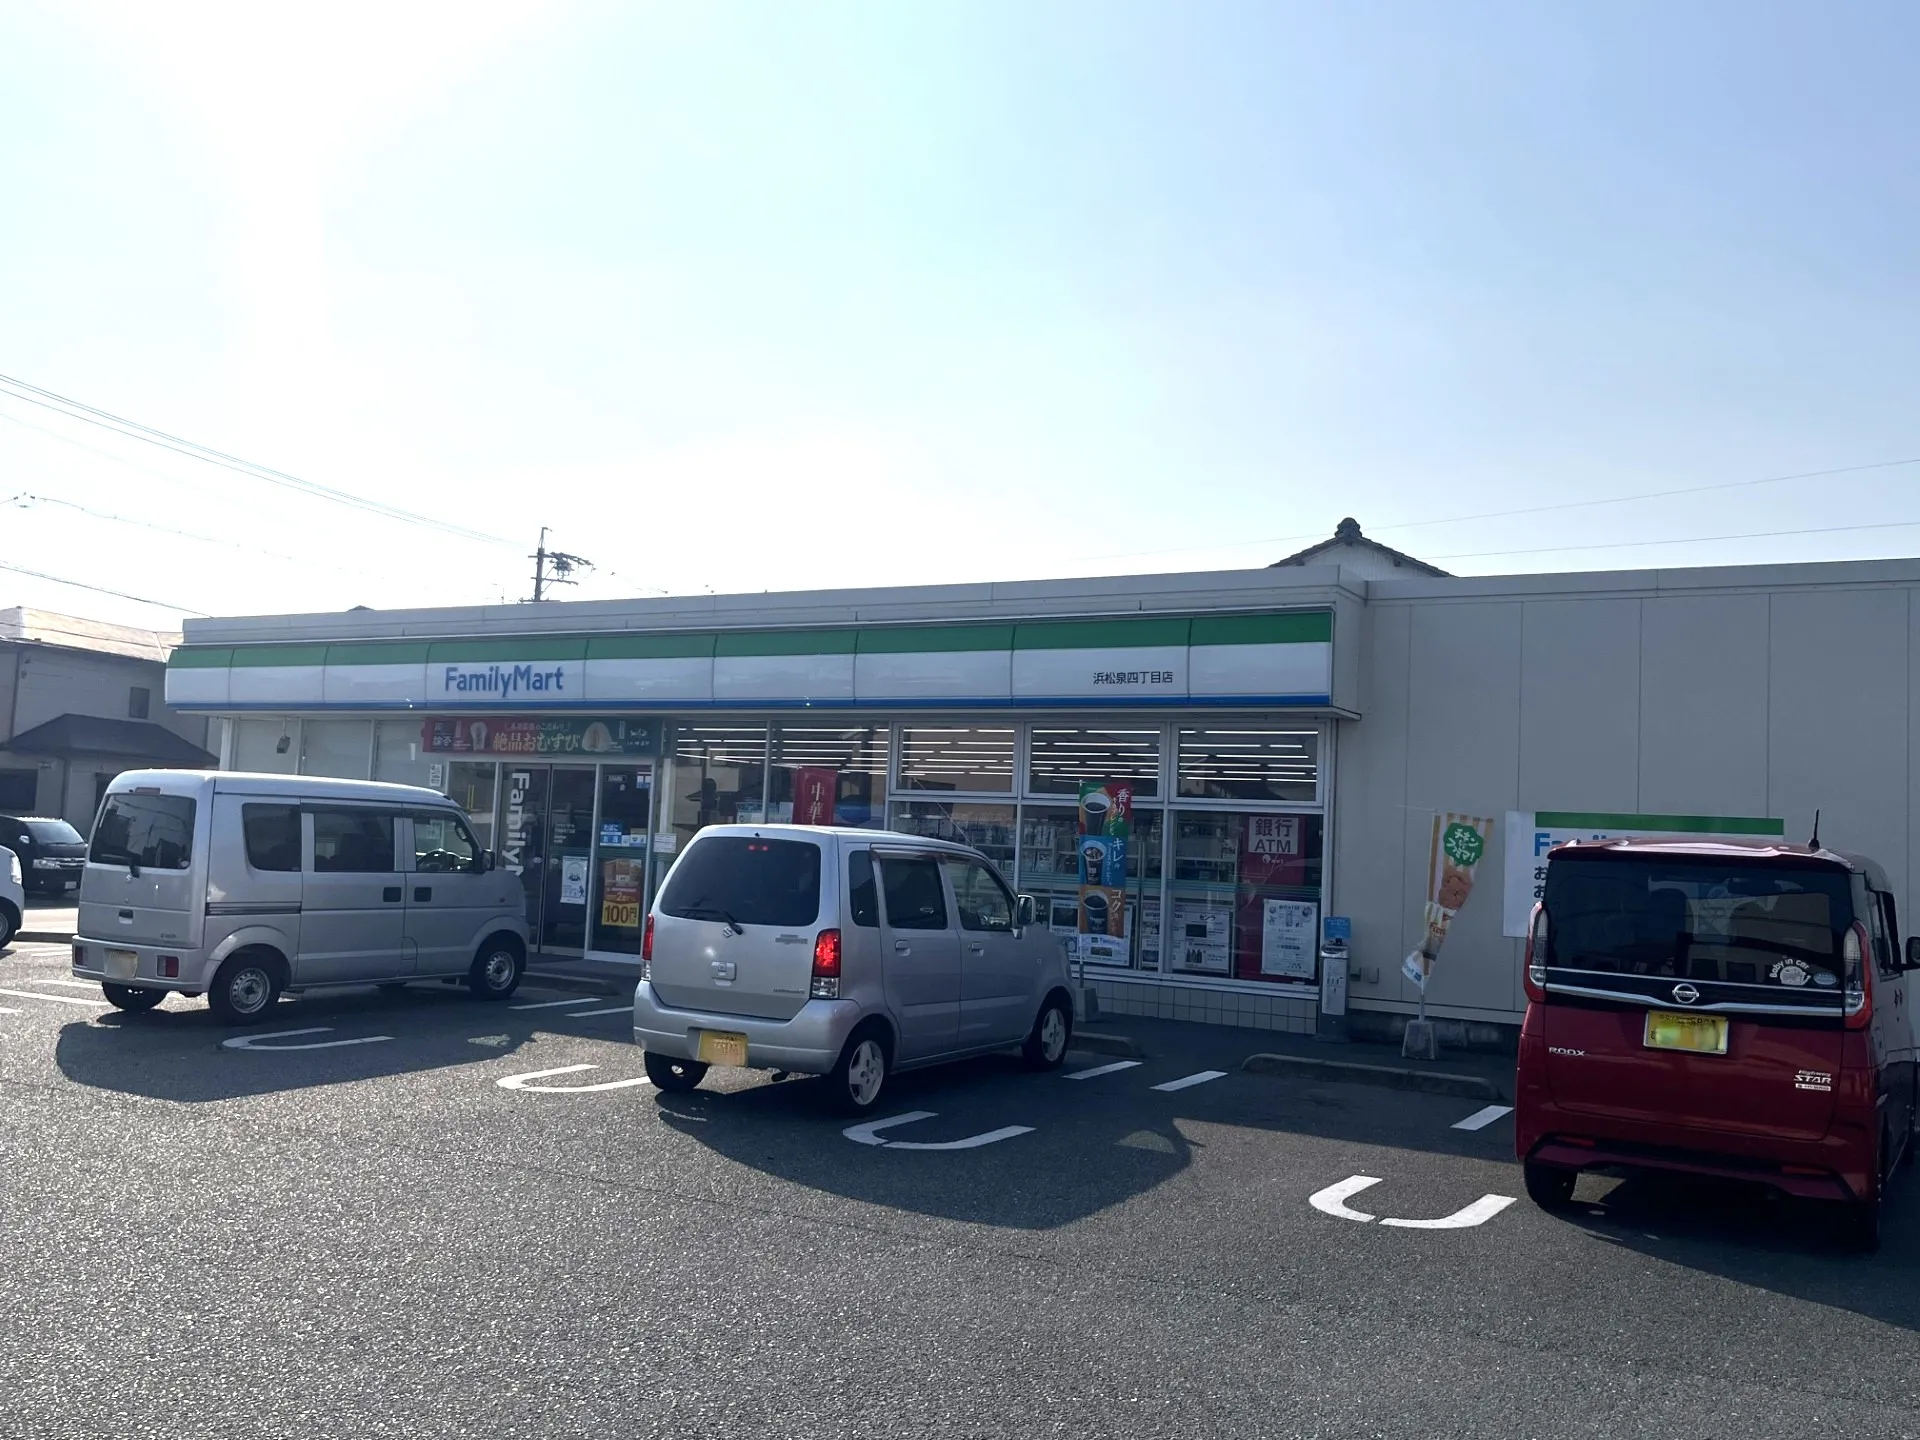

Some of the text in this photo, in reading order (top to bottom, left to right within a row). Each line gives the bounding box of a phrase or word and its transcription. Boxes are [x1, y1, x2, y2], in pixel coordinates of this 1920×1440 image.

[444, 665, 564, 697] FamilyMart
[1093, 671, 1174, 685] 浜松泉四丁目店
[493, 732, 581, 752] 絶品おむすび
[1255, 818, 1292, 837] 銀行
[1254, 839, 1291, 853] ATM
[1769, 960, 1784, 978] Baby
[1796, 959, 1810, 969] car
[1549, 1047, 1585, 1056] ROOX
[1794, 1075, 1832, 1083] STAR
